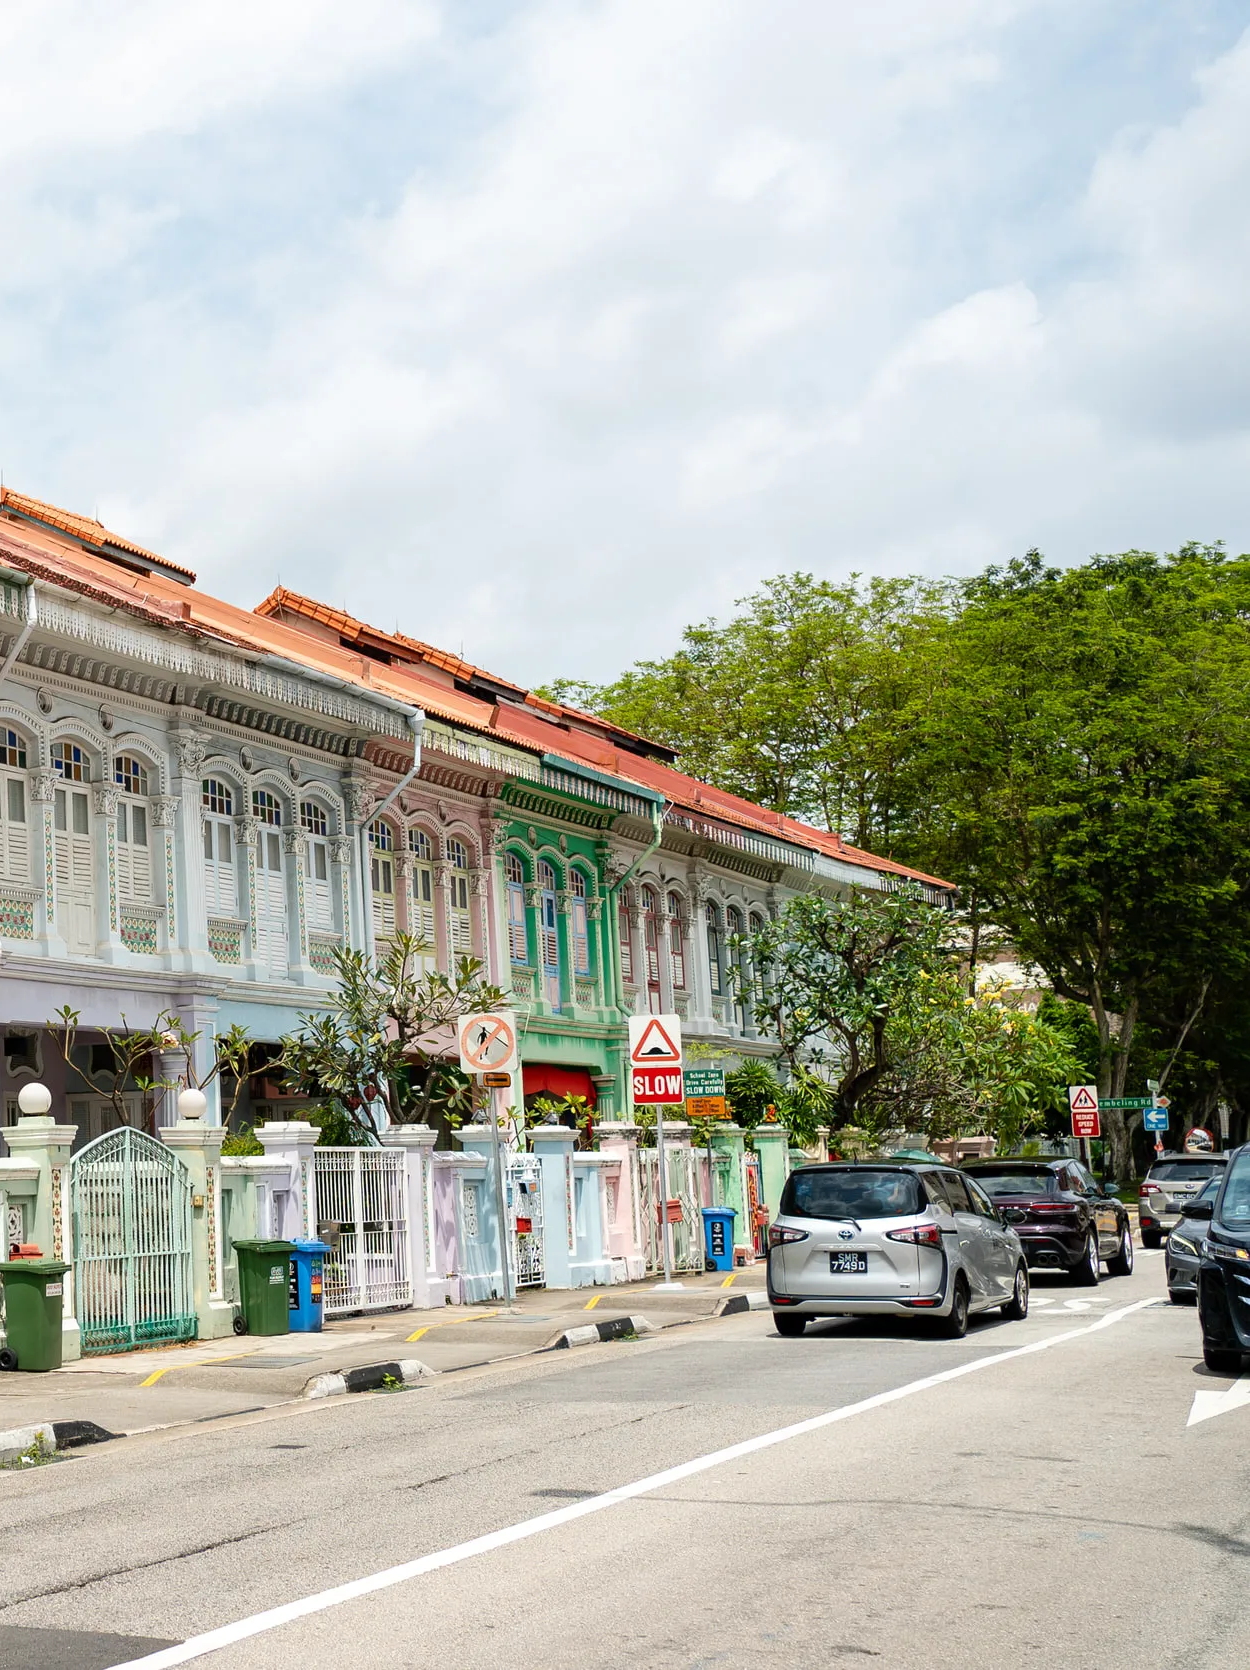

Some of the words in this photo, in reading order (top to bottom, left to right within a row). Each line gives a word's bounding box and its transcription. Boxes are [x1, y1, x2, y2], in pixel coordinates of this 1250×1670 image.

[633, 1075, 681, 1095] SLOW
[685, 1086, 704, 1095] SLOW
[704, 1085, 725, 1094] DOWN
[1099, 1099, 1139, 1108] embeling
[1141, 1098, 1151, 1106] Rd
[837, 1252, 859, 1262] SMR
[831, 1261, 866, 1271] 7749D
